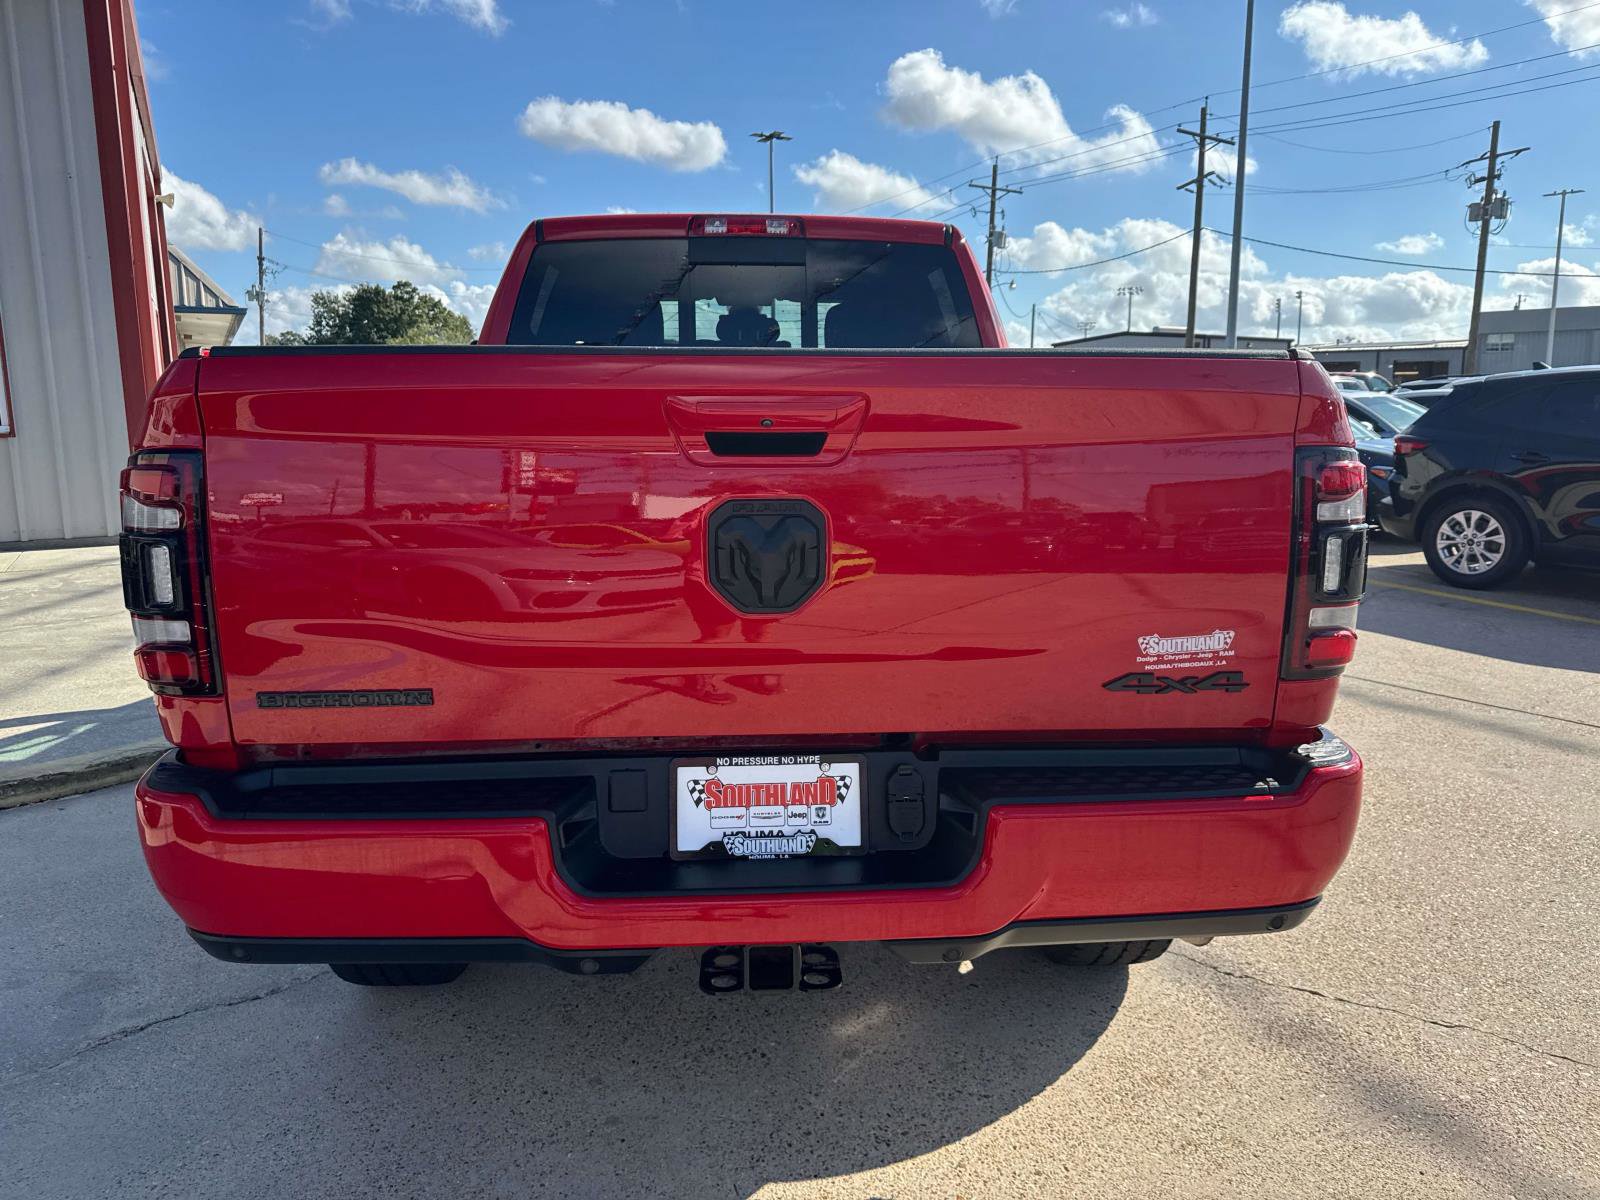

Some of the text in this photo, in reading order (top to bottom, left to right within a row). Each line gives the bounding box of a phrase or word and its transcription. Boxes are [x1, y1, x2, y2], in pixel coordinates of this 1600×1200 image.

[1148, 633, 1225, 654] SOUTHLAND
[1163, 653, 1191, 661] Chrysler
[256, 688, 434, 709] BIGHORN
[716, 755, 821, 766] NO PRESSURE NO HYPE
[704, 776, 837, 811] SOUTHLAND
[788, 811, 807, 820] Jeep
[734, 834, 807, 856] SOUTHLAND
